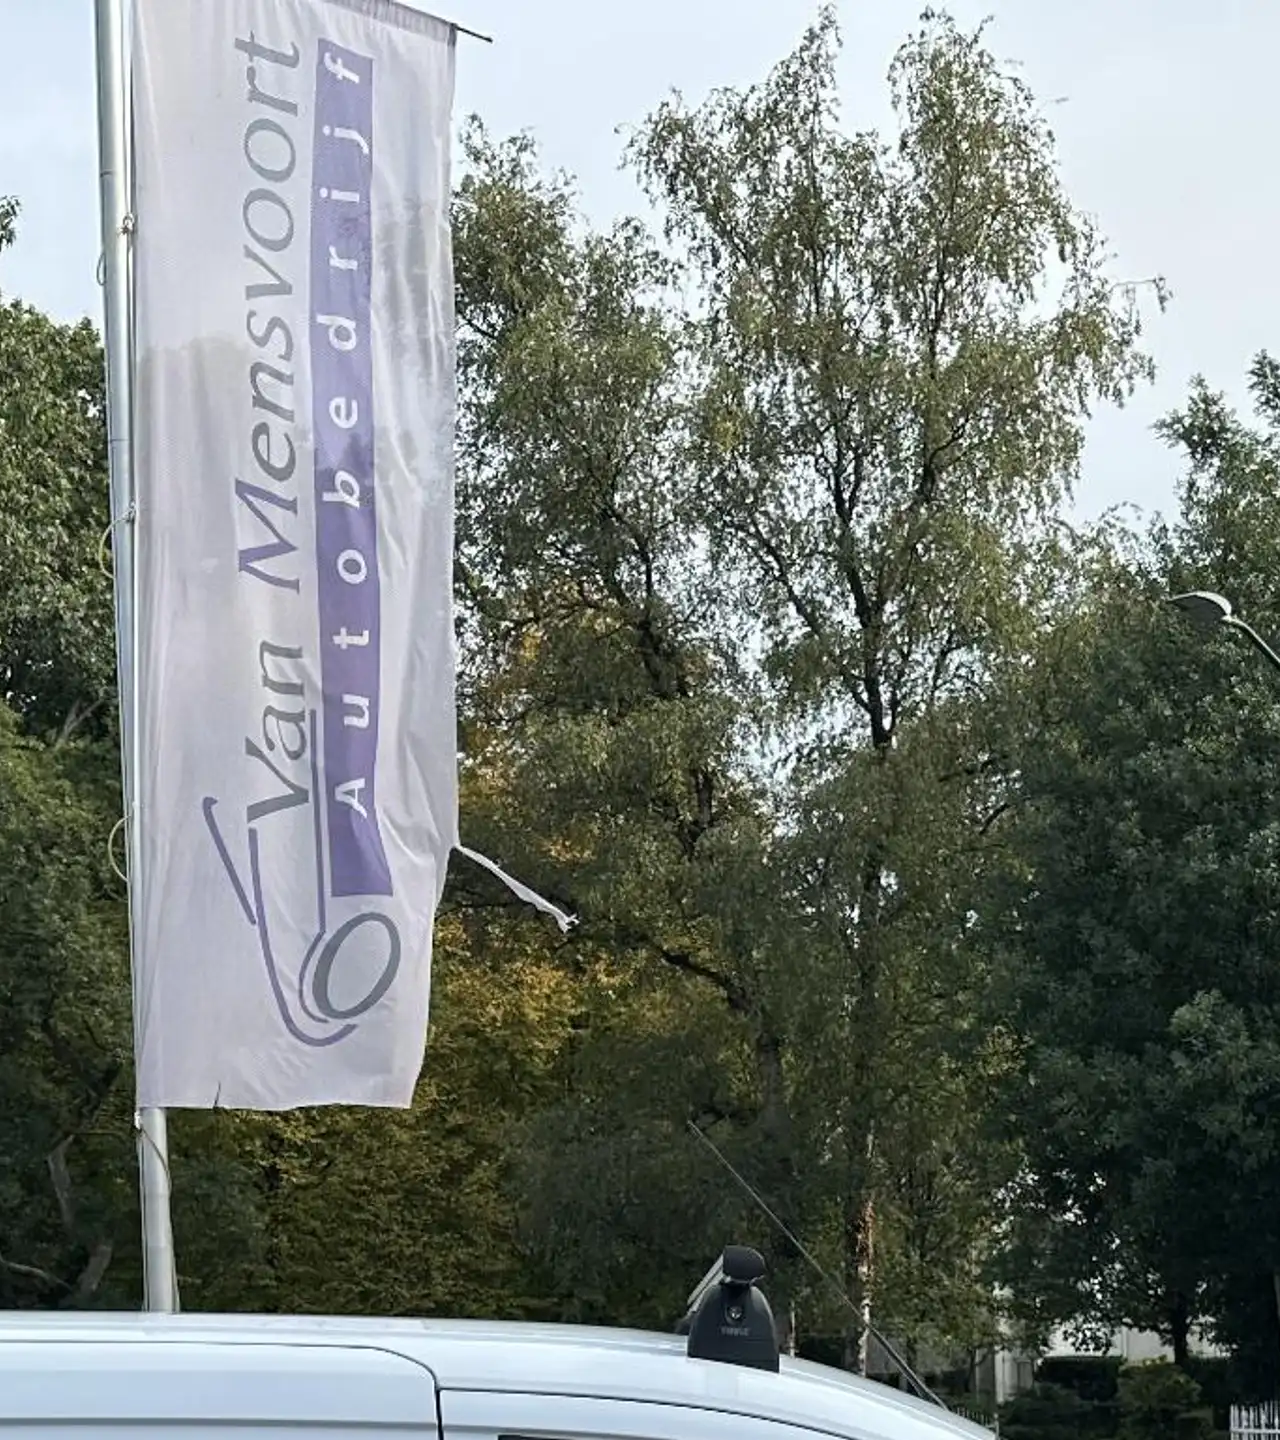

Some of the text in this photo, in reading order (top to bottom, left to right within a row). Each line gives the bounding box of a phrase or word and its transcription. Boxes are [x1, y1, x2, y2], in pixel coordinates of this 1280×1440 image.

[234, 30, 309, 823] Van Mensvoort
[318, 52, 370, 818] Autobedrijf
